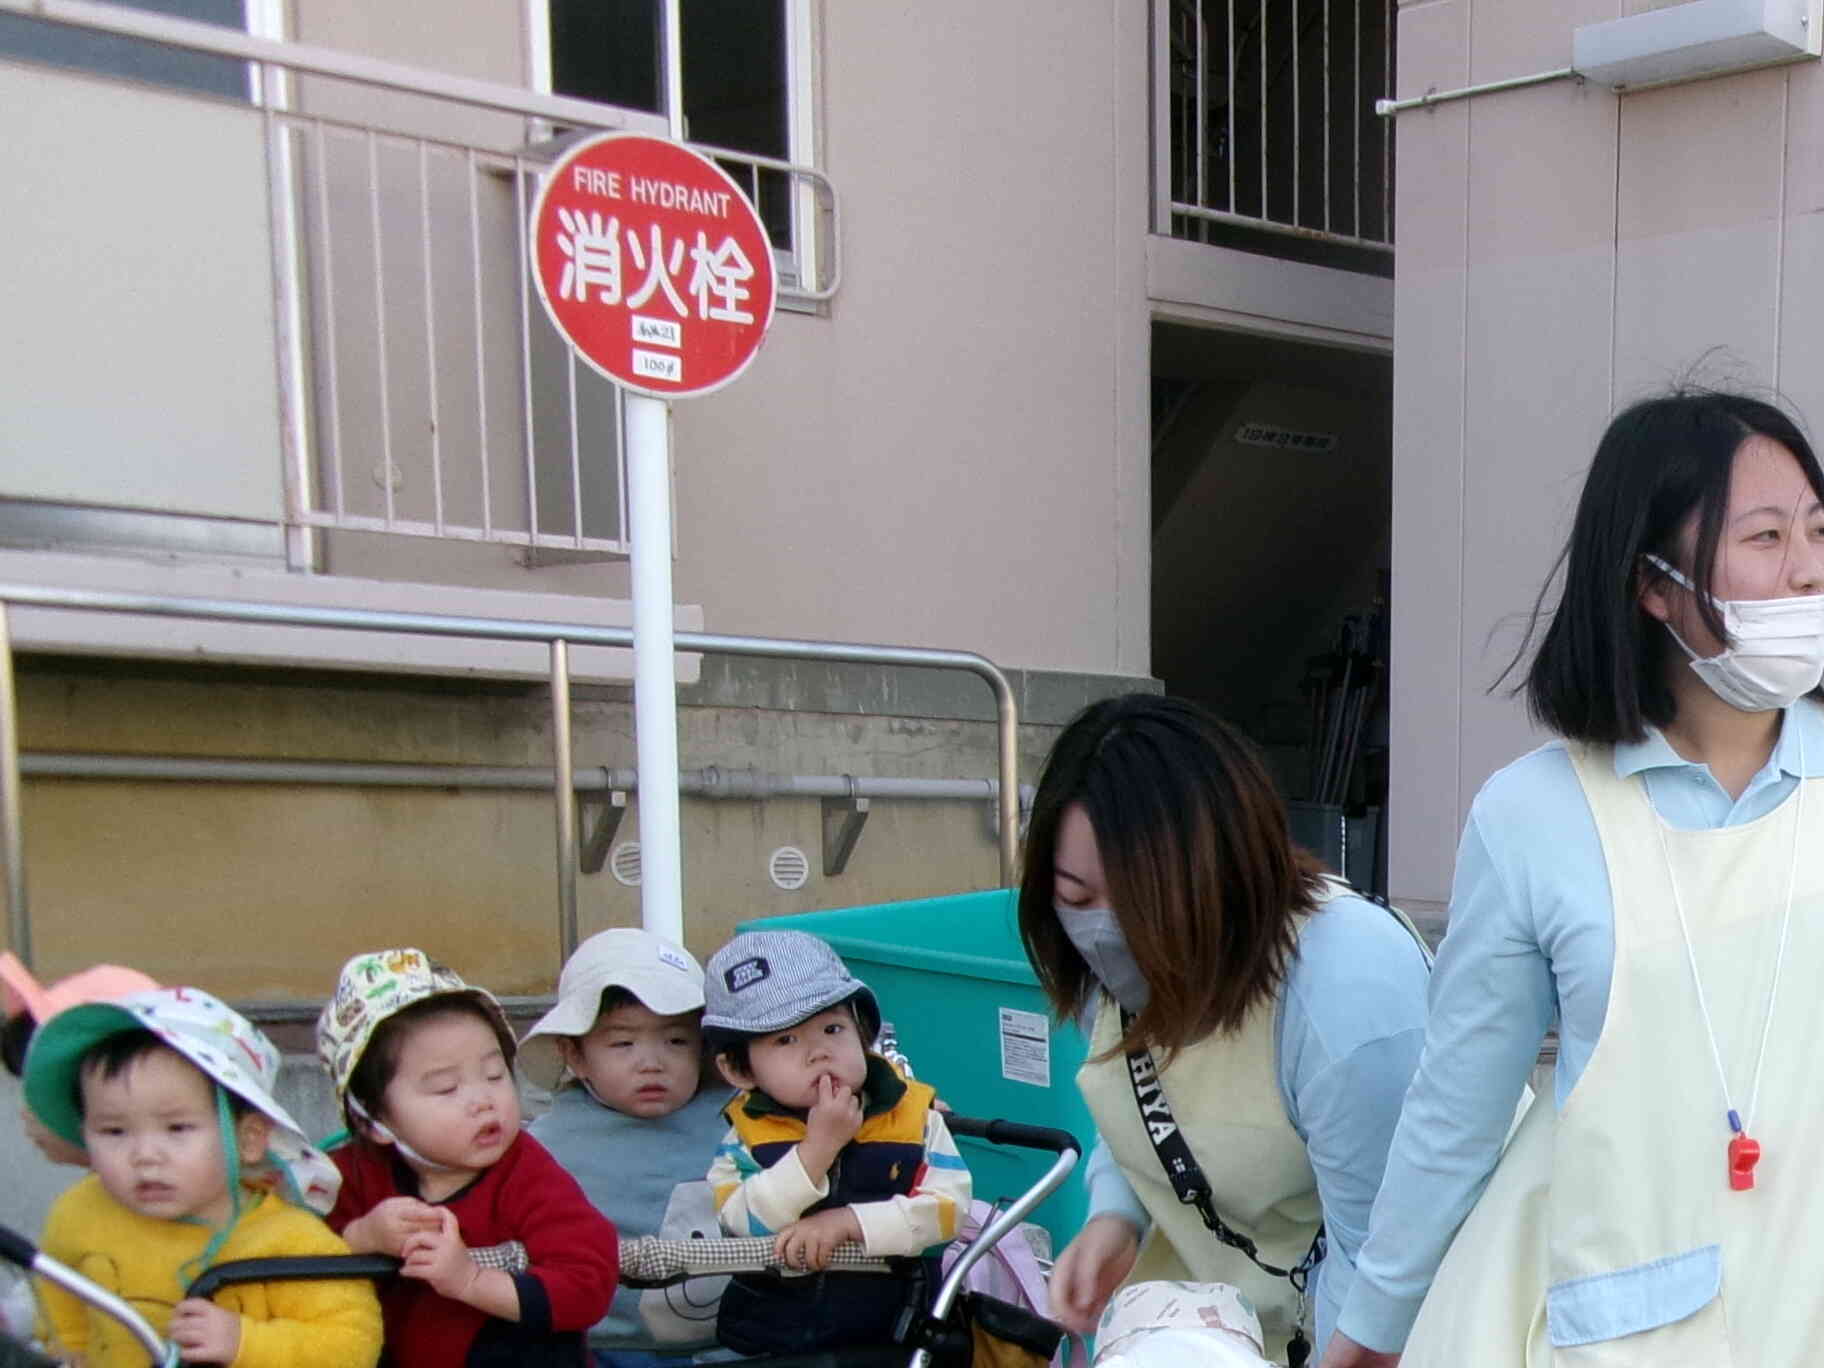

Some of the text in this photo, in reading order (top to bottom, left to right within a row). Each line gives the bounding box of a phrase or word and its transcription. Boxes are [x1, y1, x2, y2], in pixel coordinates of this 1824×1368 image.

[574, 166, 731, 219] FIRE HYDRANT
[556, 207, 755, 325] 消火栓
